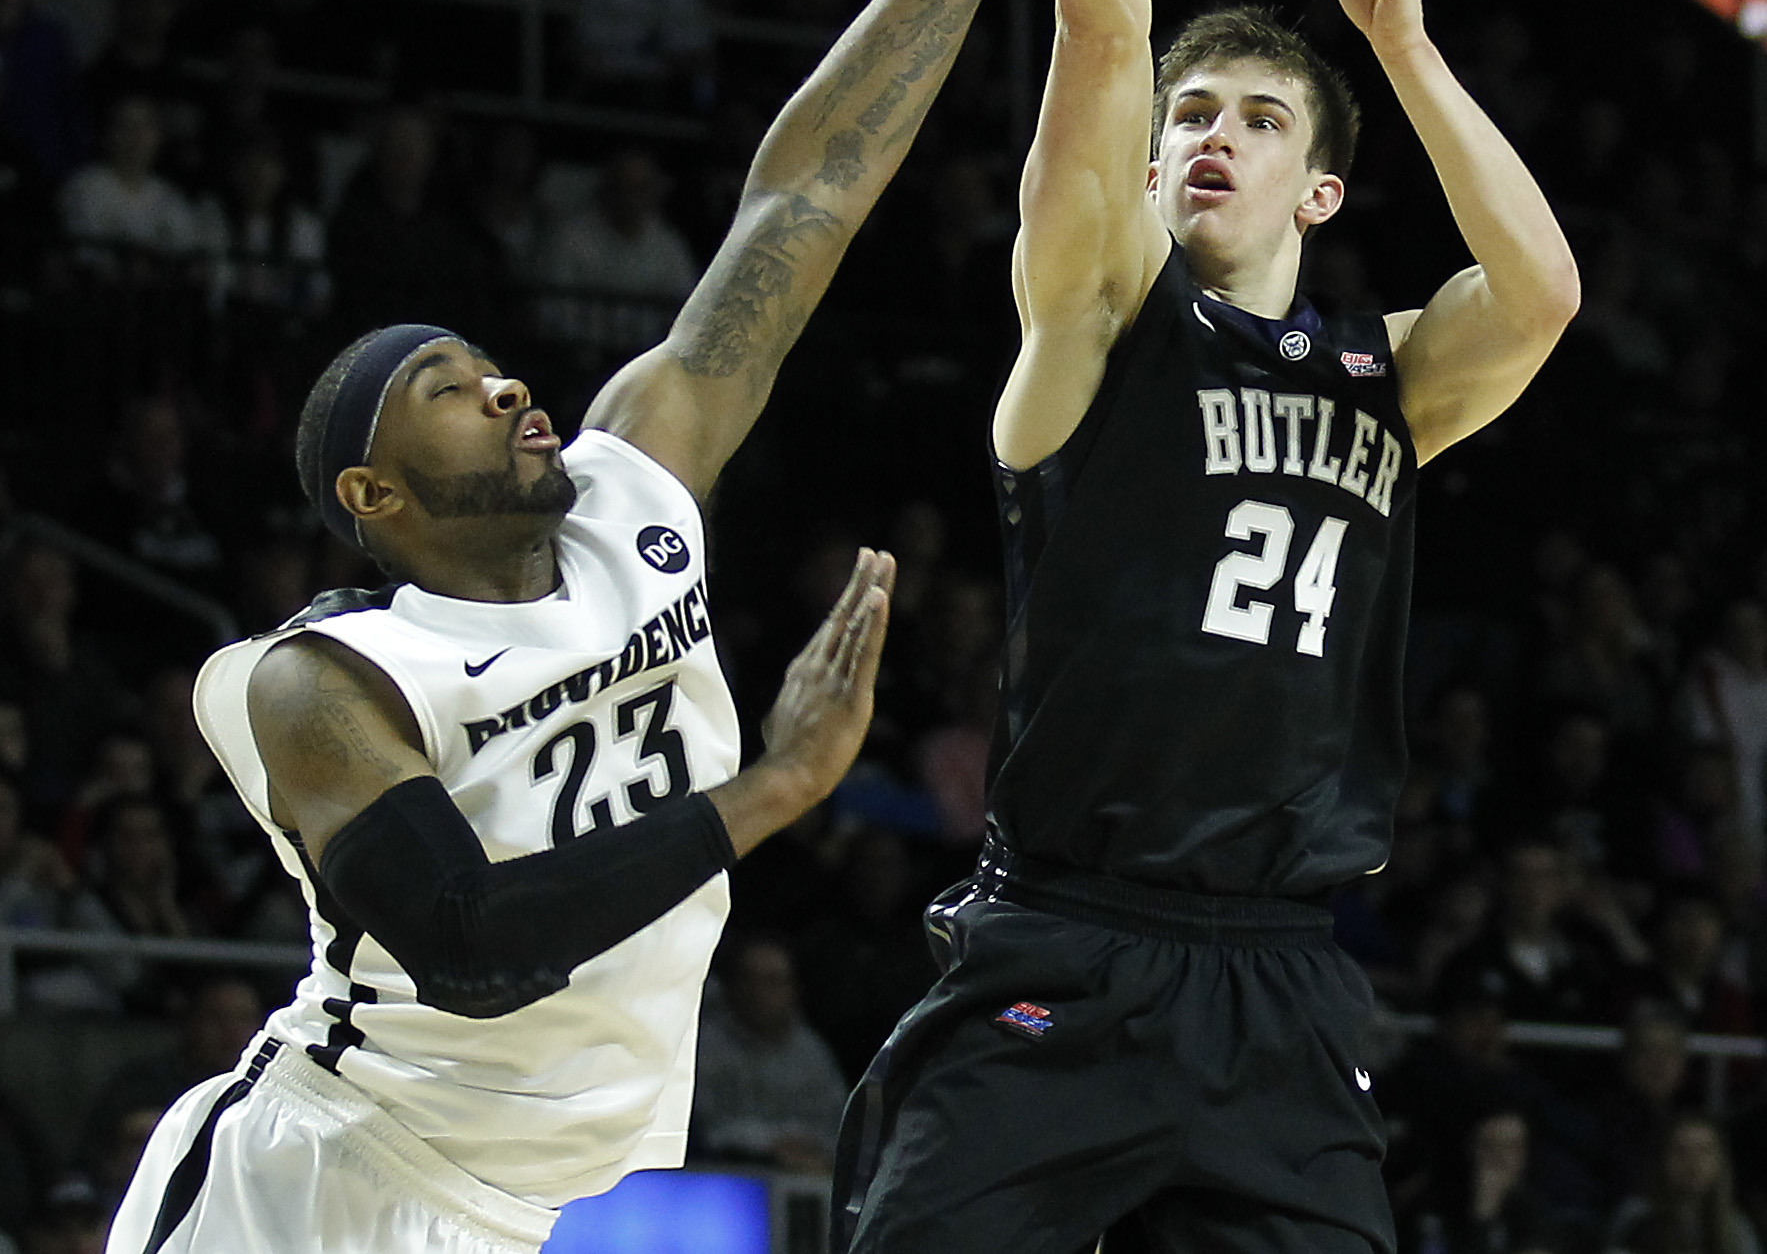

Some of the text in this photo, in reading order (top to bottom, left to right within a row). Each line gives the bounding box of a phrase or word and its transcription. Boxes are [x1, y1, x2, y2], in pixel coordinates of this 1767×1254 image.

[1342, 352, 1373, 364] BIG
[1197, 387, 1402, 517] BUTLER
[643, 531, 683, 567] DG
[1202, 499, 1349, 658] 24
[461, 580, 711, 756] PROVIDENC
[528, 672, 698, 849] 23
